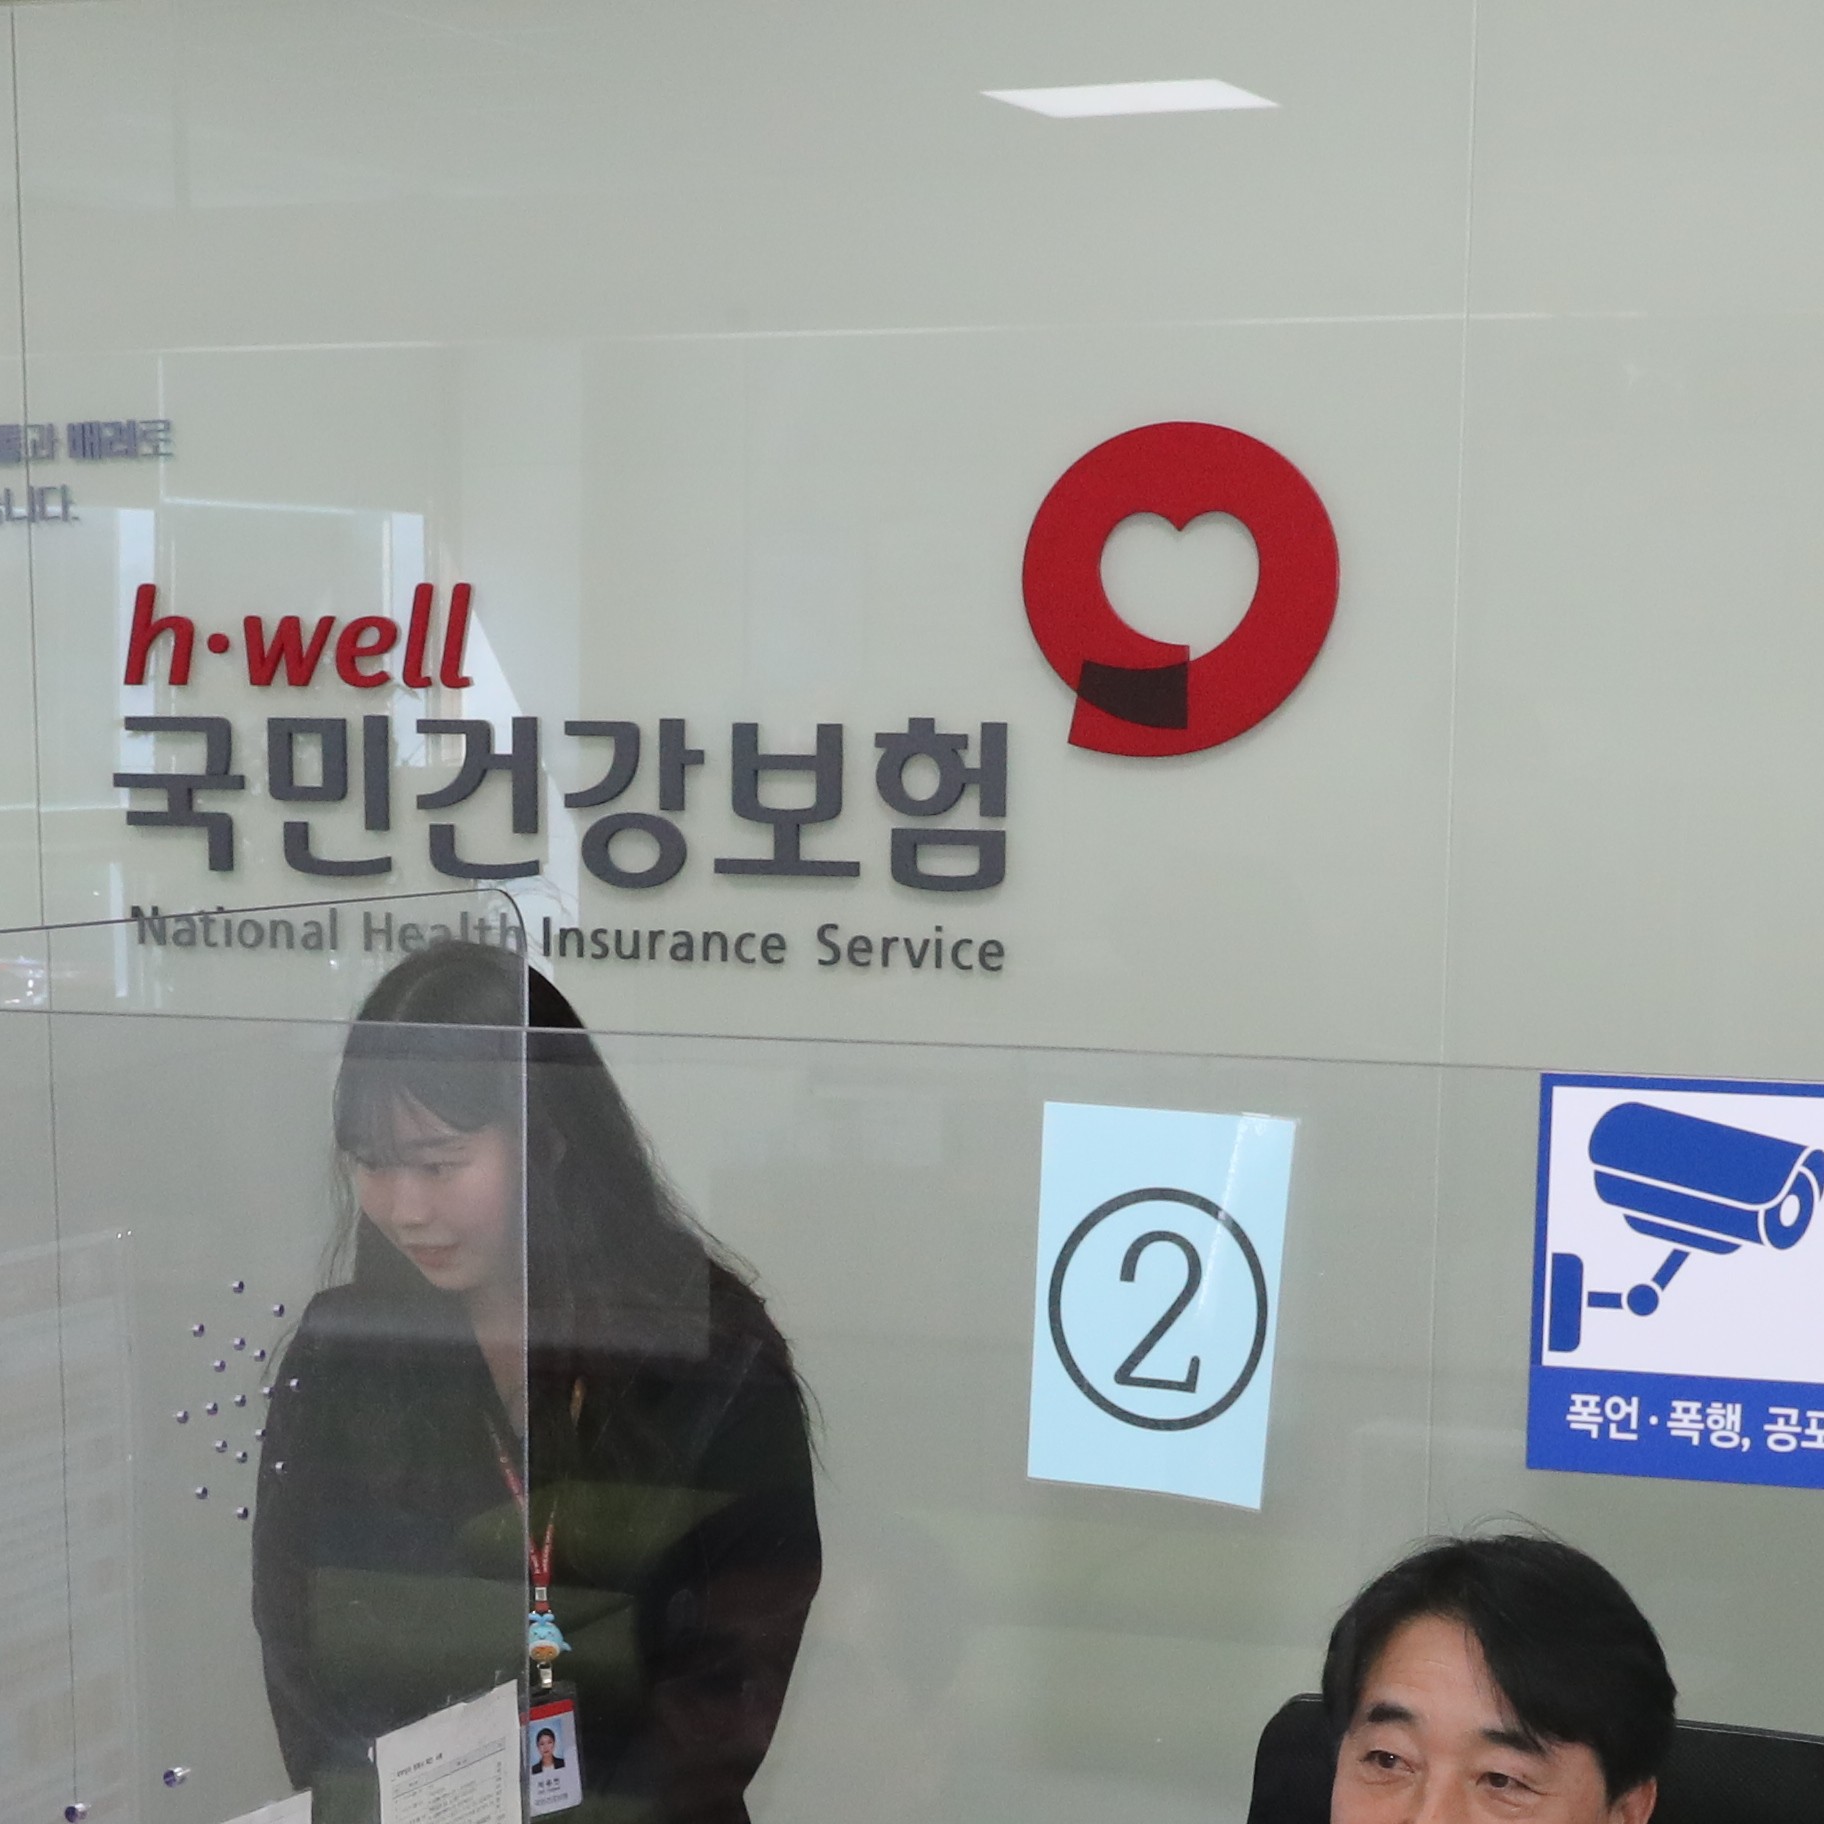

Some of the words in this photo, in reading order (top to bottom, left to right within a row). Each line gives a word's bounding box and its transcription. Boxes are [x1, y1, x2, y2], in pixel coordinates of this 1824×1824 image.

[124, 583, 471, 689] h·well
[113, 715, 1007, 896] 국민건강보험
[130, 905, 338, 952] National
[362, 911, 523, 955] Health
[542, 916, 786, 965] Insurance
[816, 921, 1007, 973] Service
[1566, 1394, 1750, 1451] 폭언·폭행,
